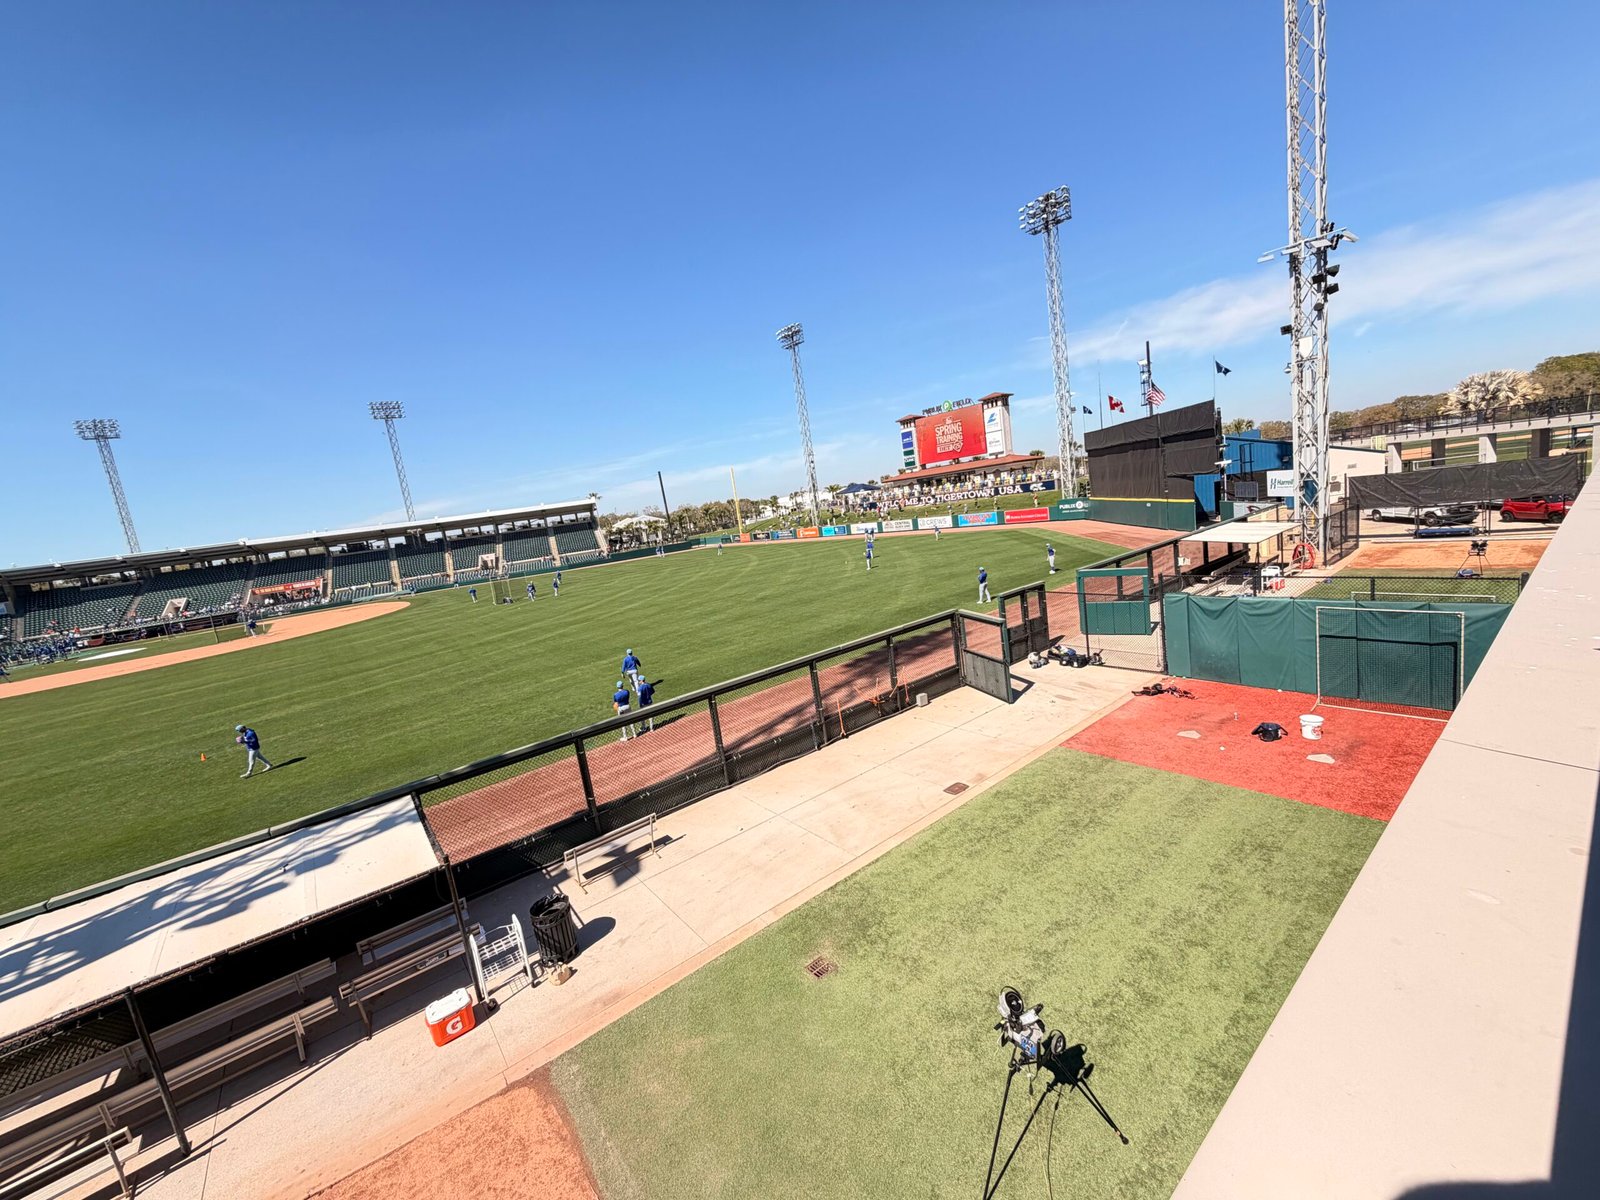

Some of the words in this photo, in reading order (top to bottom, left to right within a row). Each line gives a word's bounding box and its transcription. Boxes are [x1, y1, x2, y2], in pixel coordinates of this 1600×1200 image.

[935, 422, 962, 437] SPRING
[936, 432, 963, 444] TRAINING
[935, 488, 995, 502] TIGERTOWN
[999, 485, 1023, 495] USA
[446, 1015, 463, 1035] G
